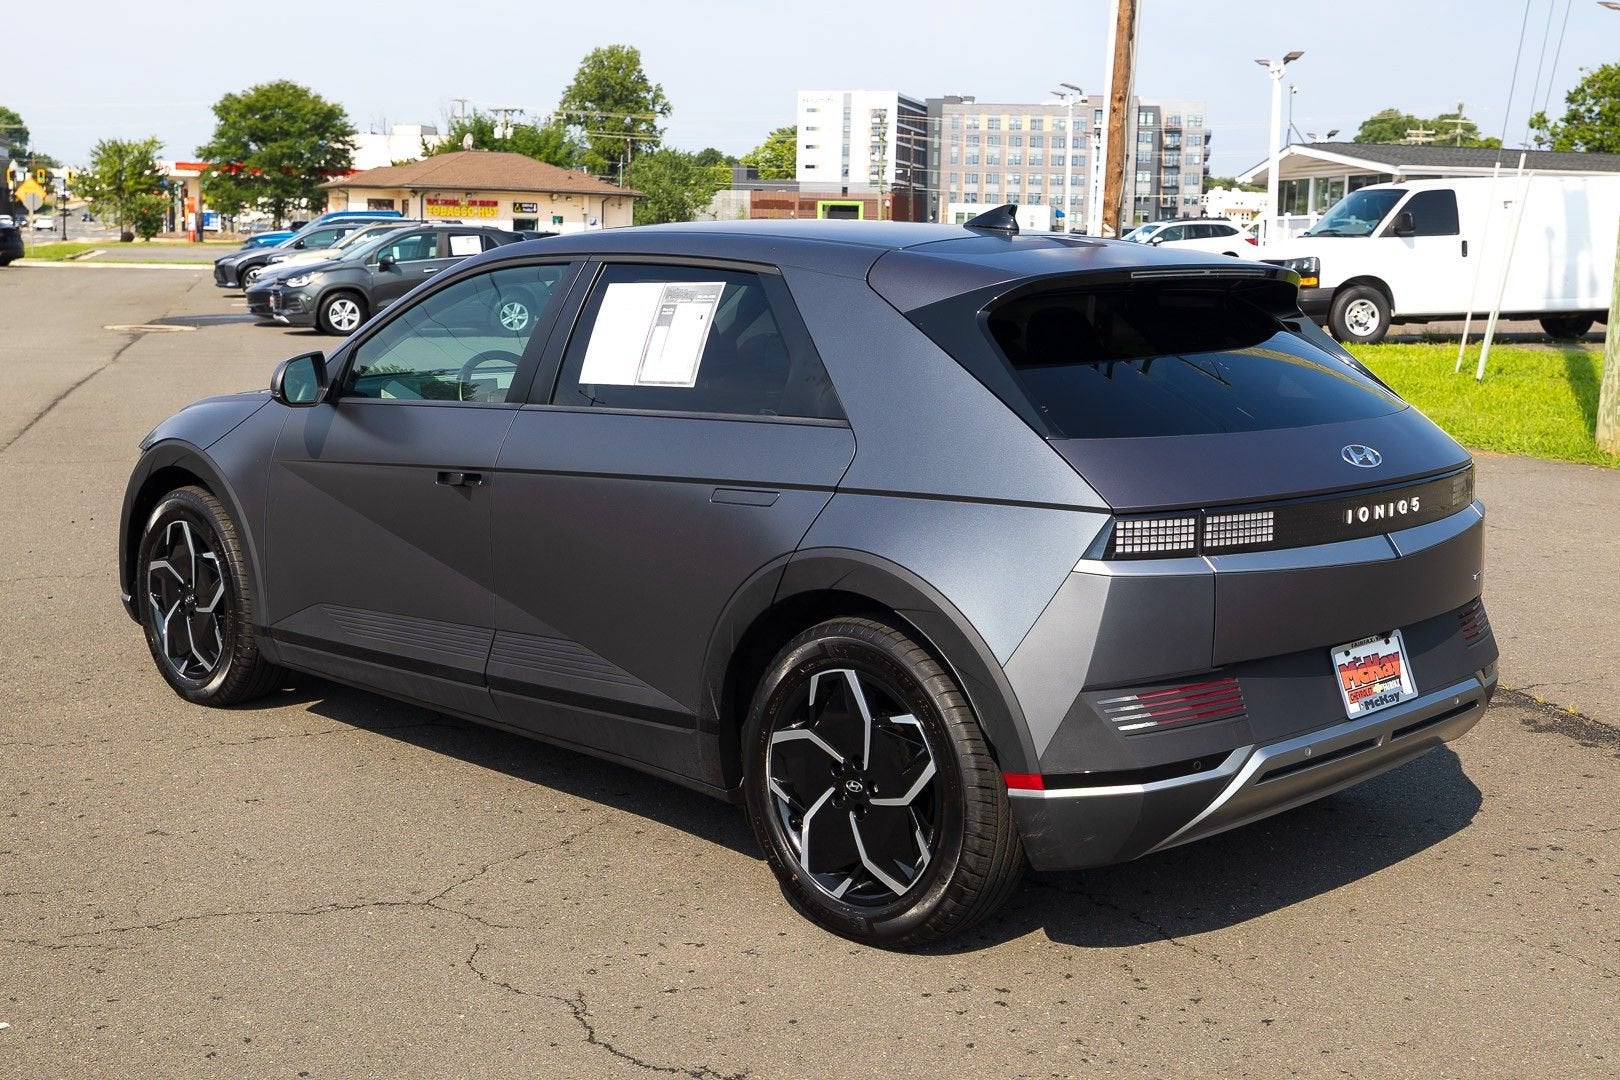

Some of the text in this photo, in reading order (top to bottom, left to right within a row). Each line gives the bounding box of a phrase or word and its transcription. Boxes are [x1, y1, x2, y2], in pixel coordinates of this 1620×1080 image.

[426, 205, 498, 217] TOBACCO HUT
[1338, 651, 1400, 691] McKay
[1363, 691, 1400, 711] McKay
